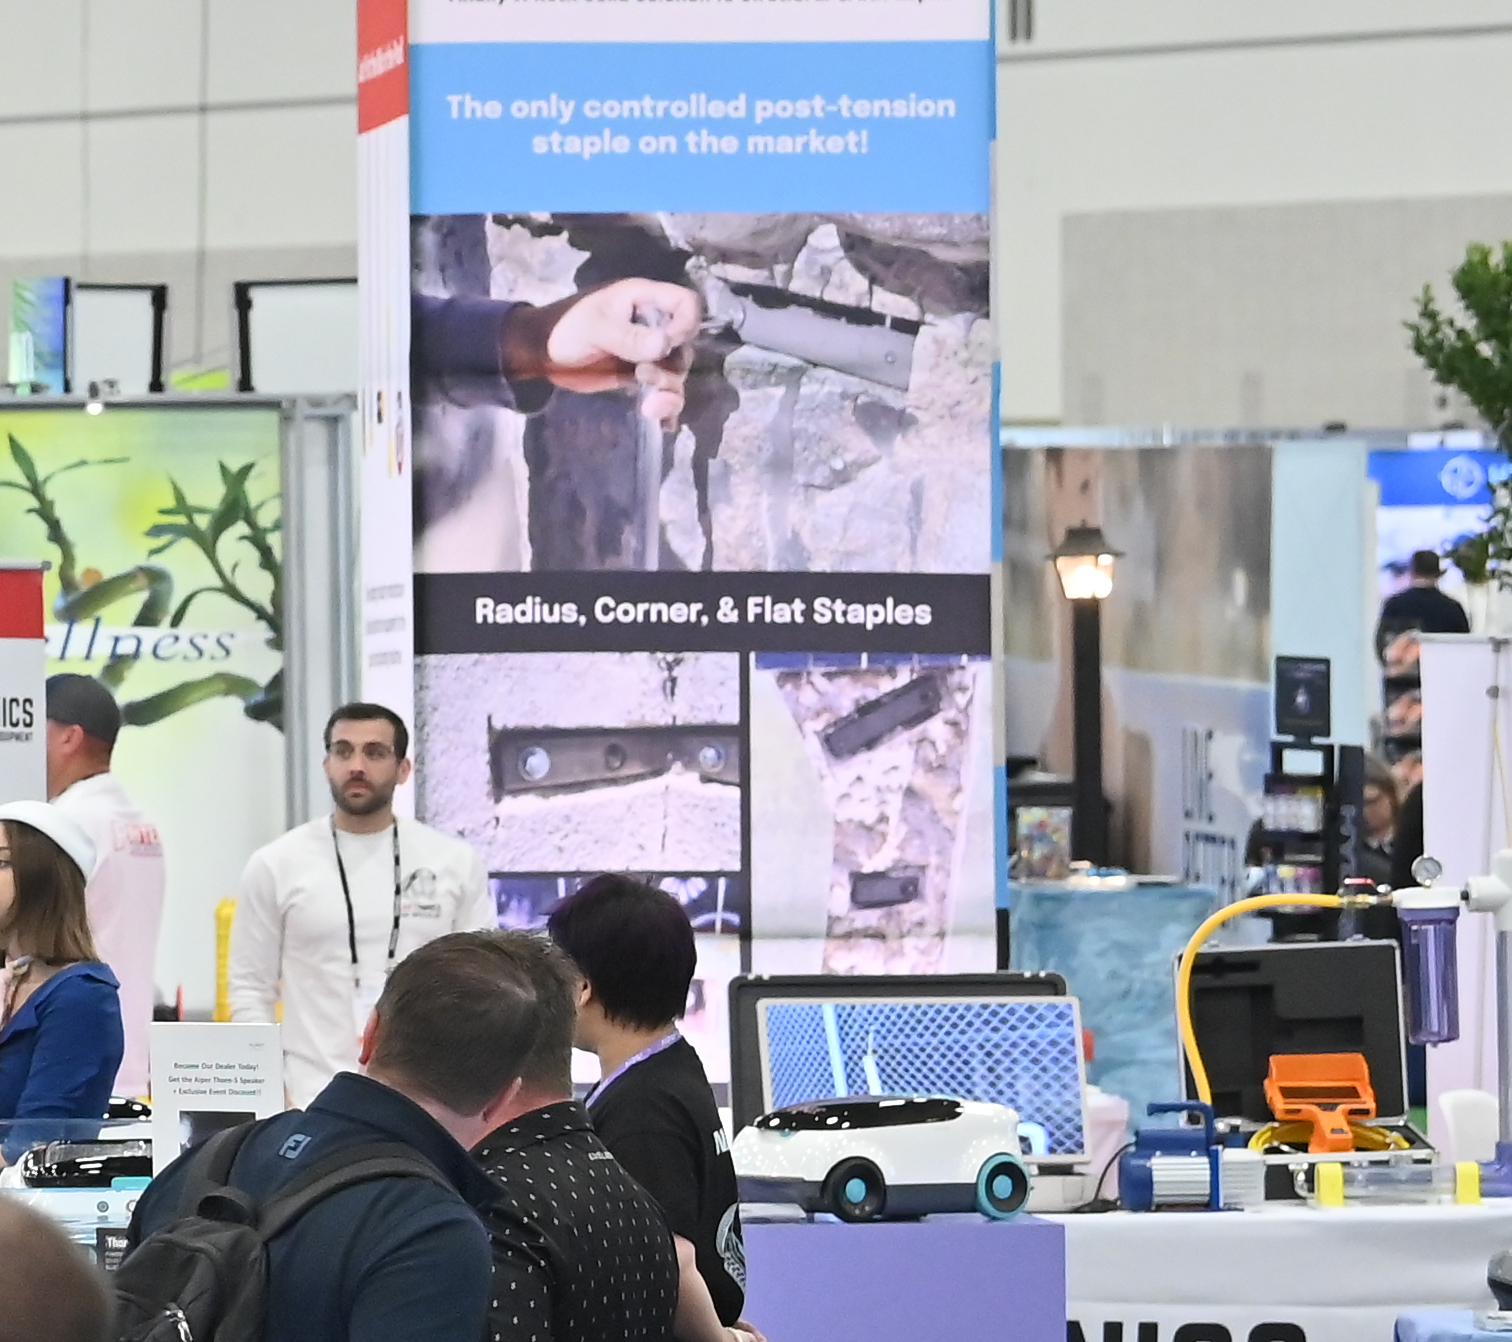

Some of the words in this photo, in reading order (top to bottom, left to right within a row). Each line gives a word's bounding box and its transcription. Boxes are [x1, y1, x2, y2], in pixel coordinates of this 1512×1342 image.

[446, 94, 503, 119] The
[509, 93, 577, 124] only
[582, 93, 747, 119] controlled
[755, 93, 957, 123] post-tension
[531, 128, 632, 159] staple
[638, 134, 677, 154] on
[685, 129, 740, 154] the
[747, 128, 868, 154] market!
[475, 596, 587, 627] Radius,
[594, 596, 709, 627] Corner,
[716, 597, 739, 624] &
[747, 596, 806, 624] Flat
[812, 596, 932, 630] Staples
